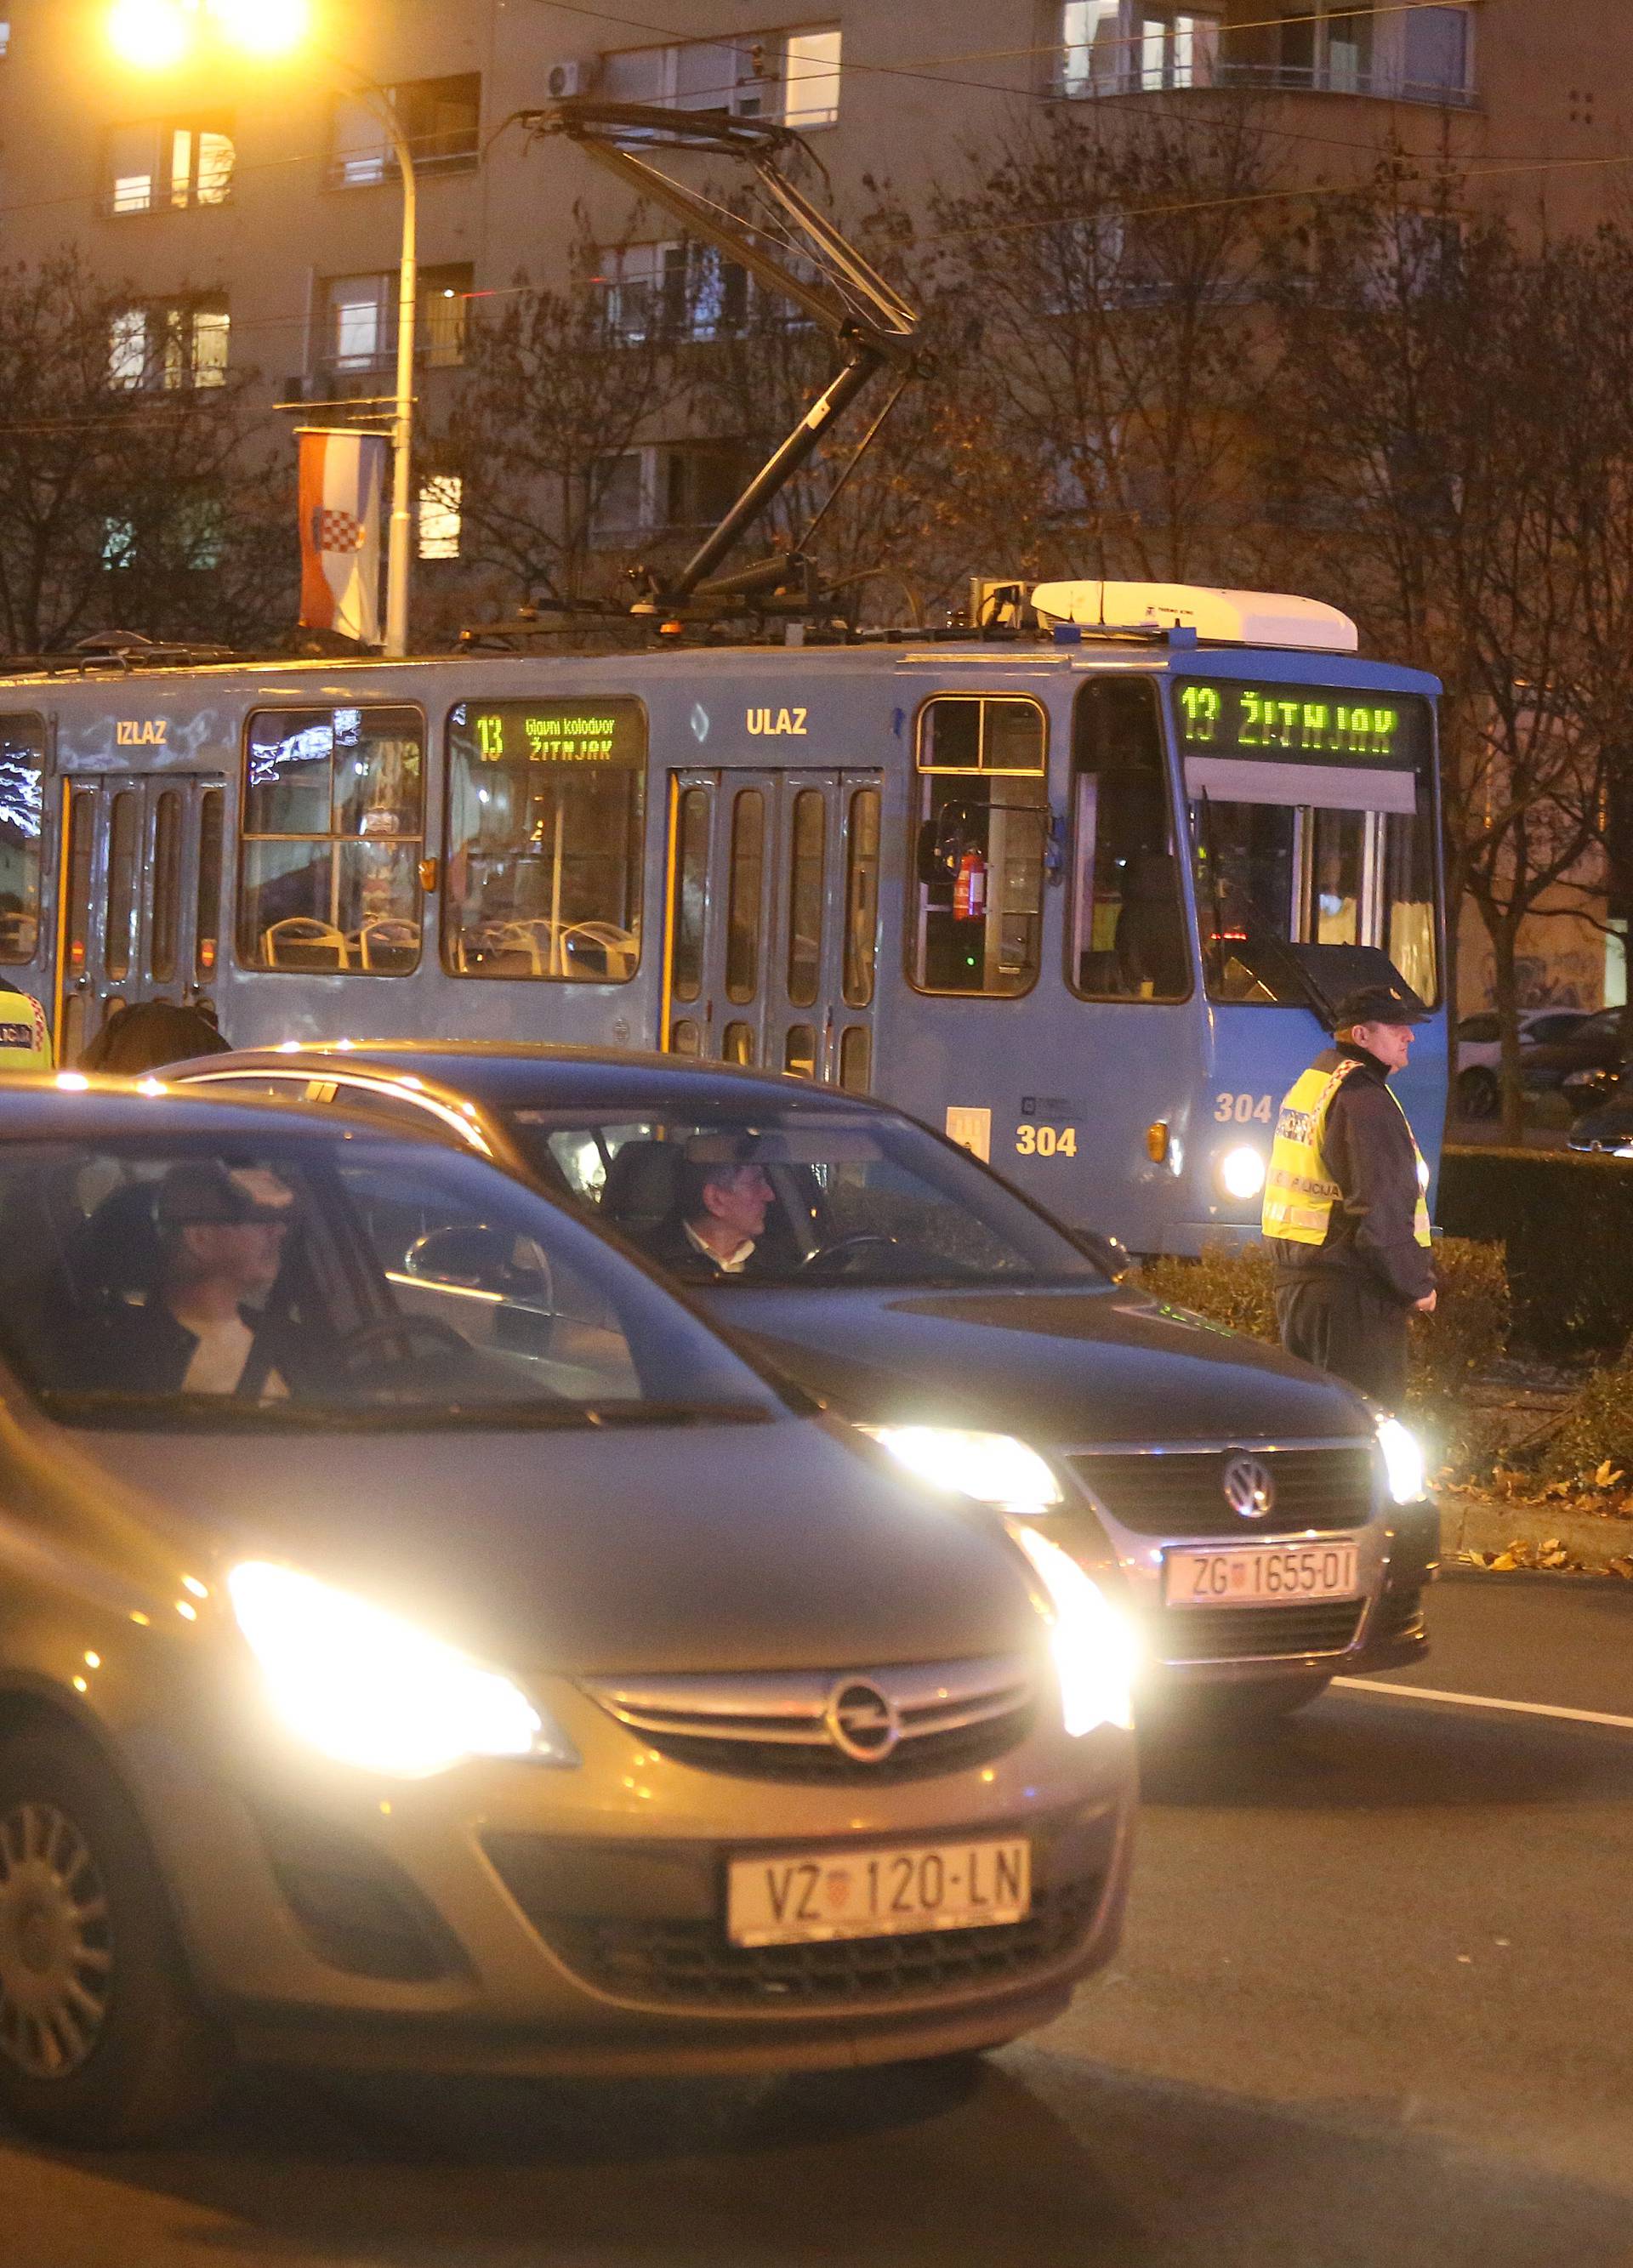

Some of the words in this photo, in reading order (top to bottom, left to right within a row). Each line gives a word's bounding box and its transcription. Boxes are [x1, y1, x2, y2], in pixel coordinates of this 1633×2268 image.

[563, 717, 616, 735] kolodvor
[746, 708, 807, 736] ULAZ
[1182, 685, 1217, 741] 13
[117, 720, 168, 745] IZLAZ
[476, 716, 504, 762] 13
[528, 736, 613, 762] ŽITNJAK
[1213, 1093, 1273, 1124] 304
[1016, 1124, 1078, 1157] 304
[1193, 1557, 1227, 1594] ZG
[766, 1863, 821, 1923] VZ
[868, 1848, 1021, 1915] 120-LN
